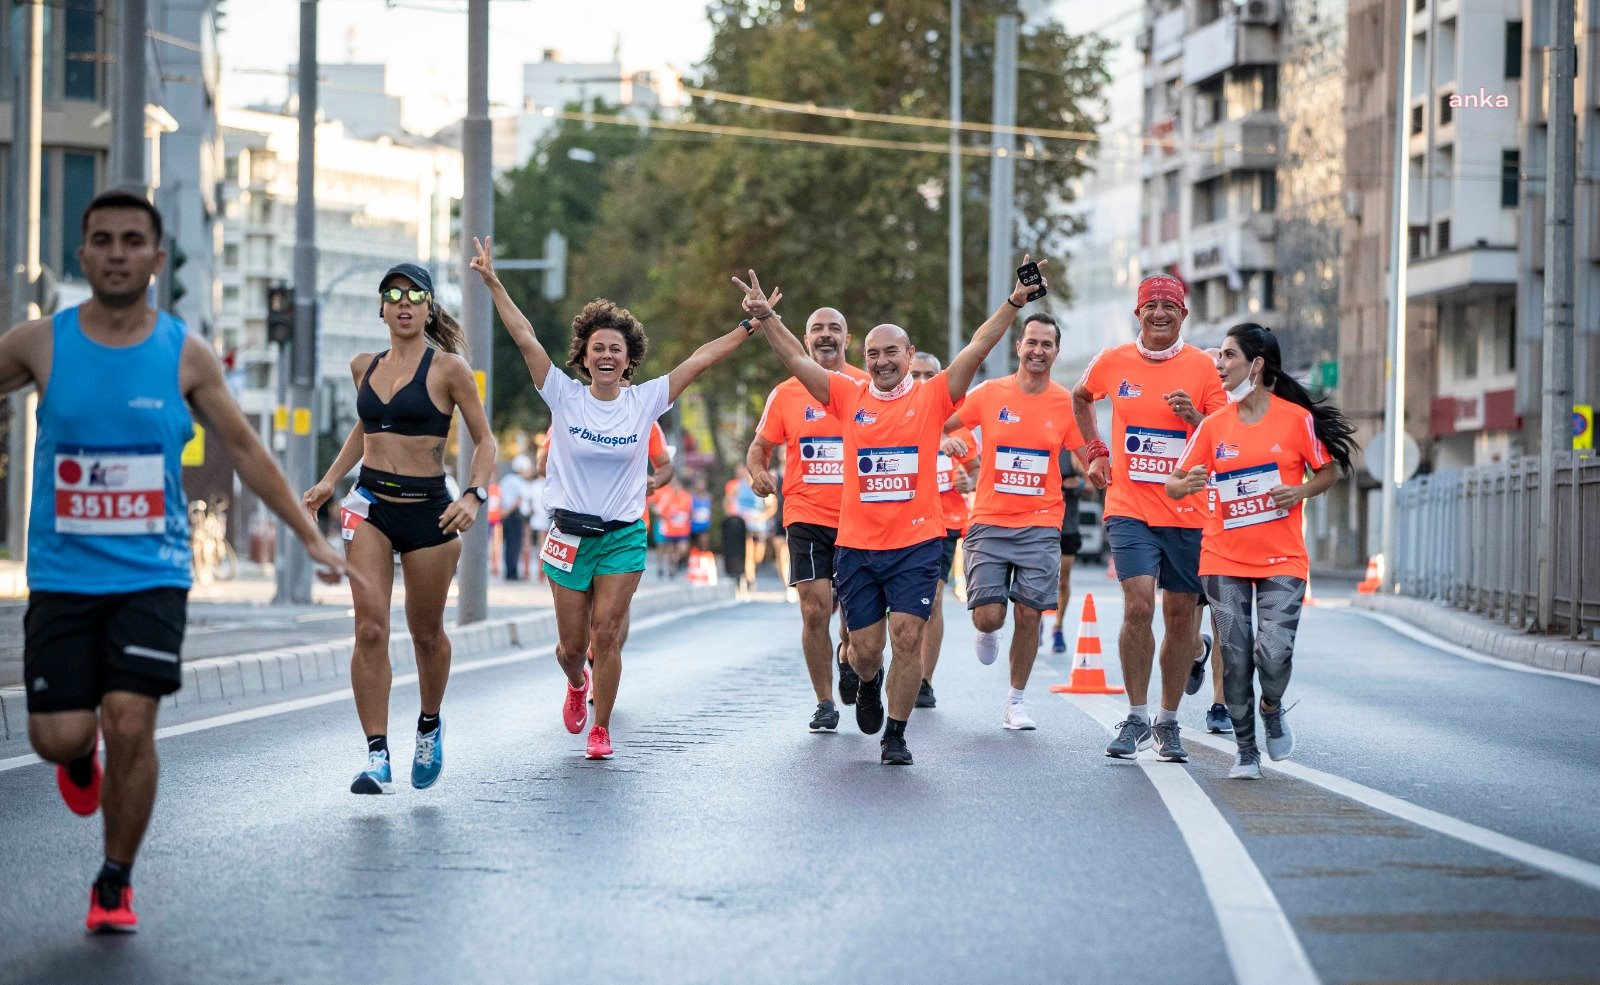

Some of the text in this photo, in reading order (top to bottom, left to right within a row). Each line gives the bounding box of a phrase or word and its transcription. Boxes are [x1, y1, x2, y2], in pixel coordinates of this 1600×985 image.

[1023, 274, 1038, 284] 0.20
[1129, 457, 1173, 472] 35501
[866, 477, 910, 491] 35001
[1001, 472, 1040, 486] 35519
[69, 494, 150, 518] 35156
[1229, 495, 1277, 517] 35514
